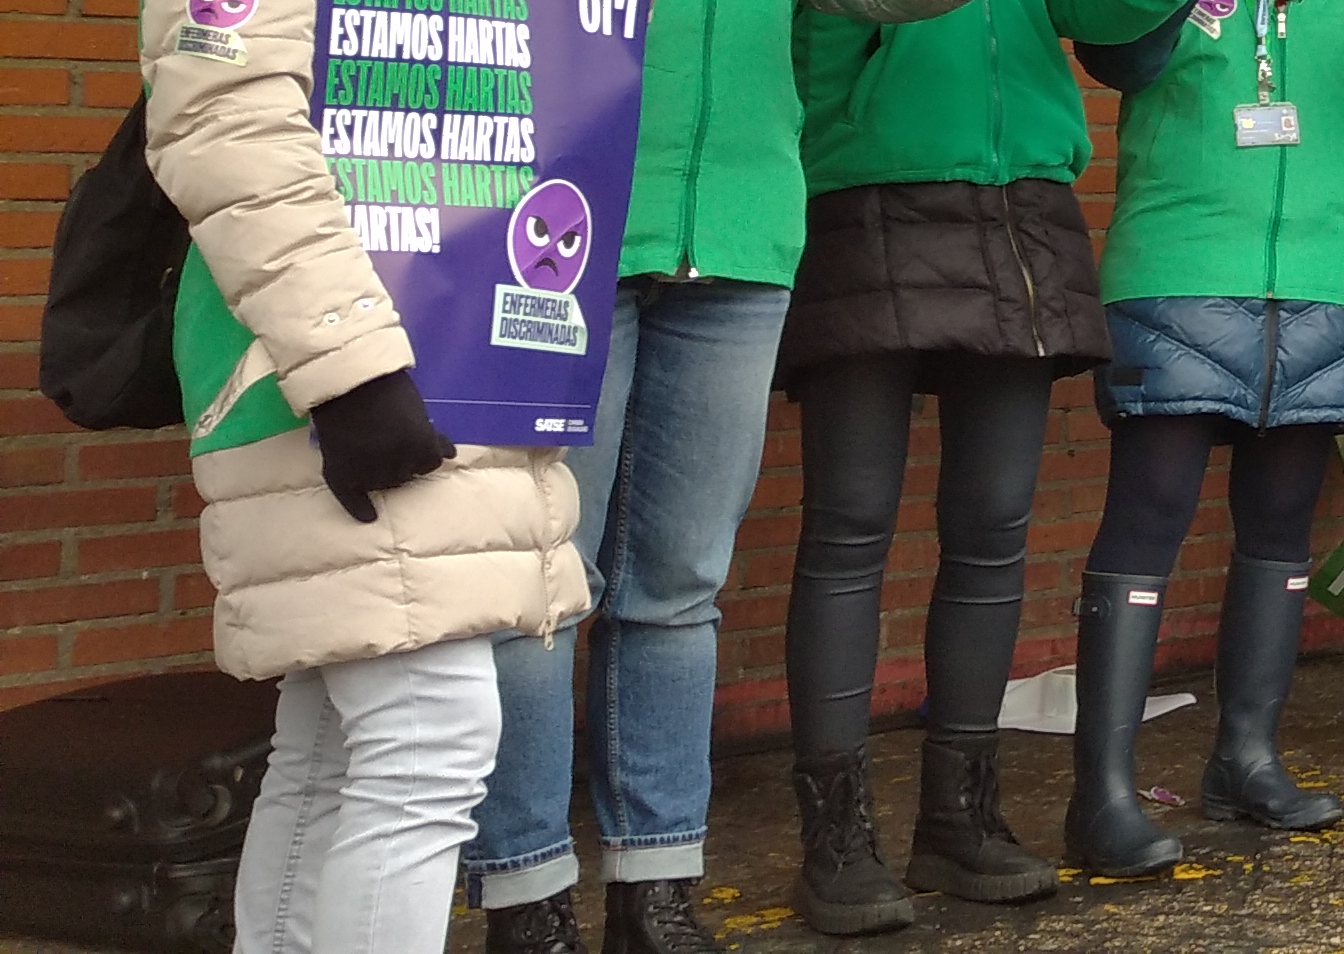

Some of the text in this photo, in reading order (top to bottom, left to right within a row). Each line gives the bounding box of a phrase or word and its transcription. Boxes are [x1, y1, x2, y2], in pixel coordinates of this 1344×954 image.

[329, 8, 531, 69] ESTAMOS HARTAS
[325, 58, 533, 116] ESTAMOS HARTAS
[321, 109, 536, 164] ESTAMOS HARTAS
[326, 157, 534, 210] STAMOS HARTAS
[344, 205, 441, 253] ARTAS!
[499, 317, 578, 347] DISCRIMINADAS
[502, 292, 571, 322] ENFERMERAS
